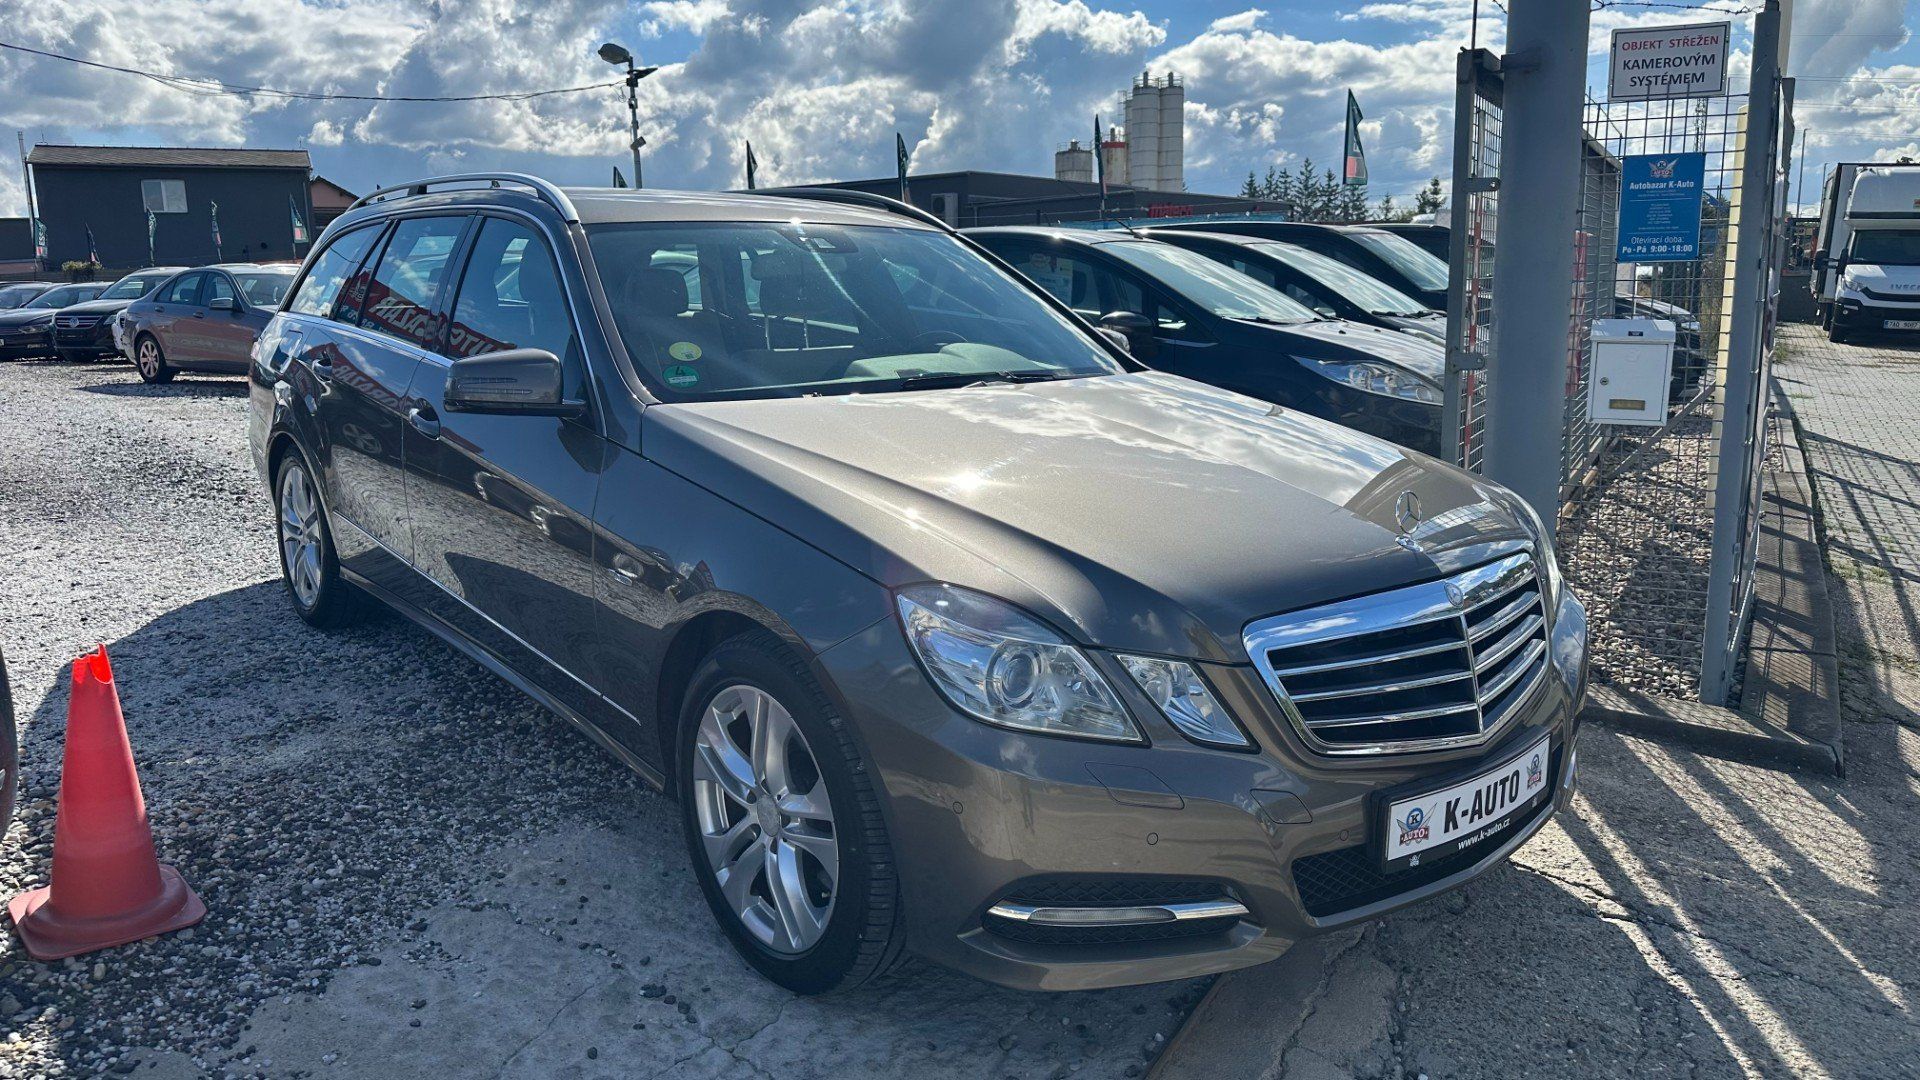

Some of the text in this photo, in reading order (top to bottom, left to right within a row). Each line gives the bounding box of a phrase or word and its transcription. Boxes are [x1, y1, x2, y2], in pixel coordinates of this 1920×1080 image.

[1621, 34, 1719, 51] OBJEKT STŘEŽEN
[1623, 52, 1715, 71] KAMEROVÝM
[1629, 71, 1705, 87] SYSTÉMEM
[1629, 180, 1695, 190] Autobazar K-Auto
[1664, 235, 1685, 243] doba:
[1443, 769, 1520, 834] K-AUTO
[1410, 813, 1420, 825] K
[1402, 828, 1425, 843] AUTO
[1457, 818, 1511, 851] www.k-auto.cz
